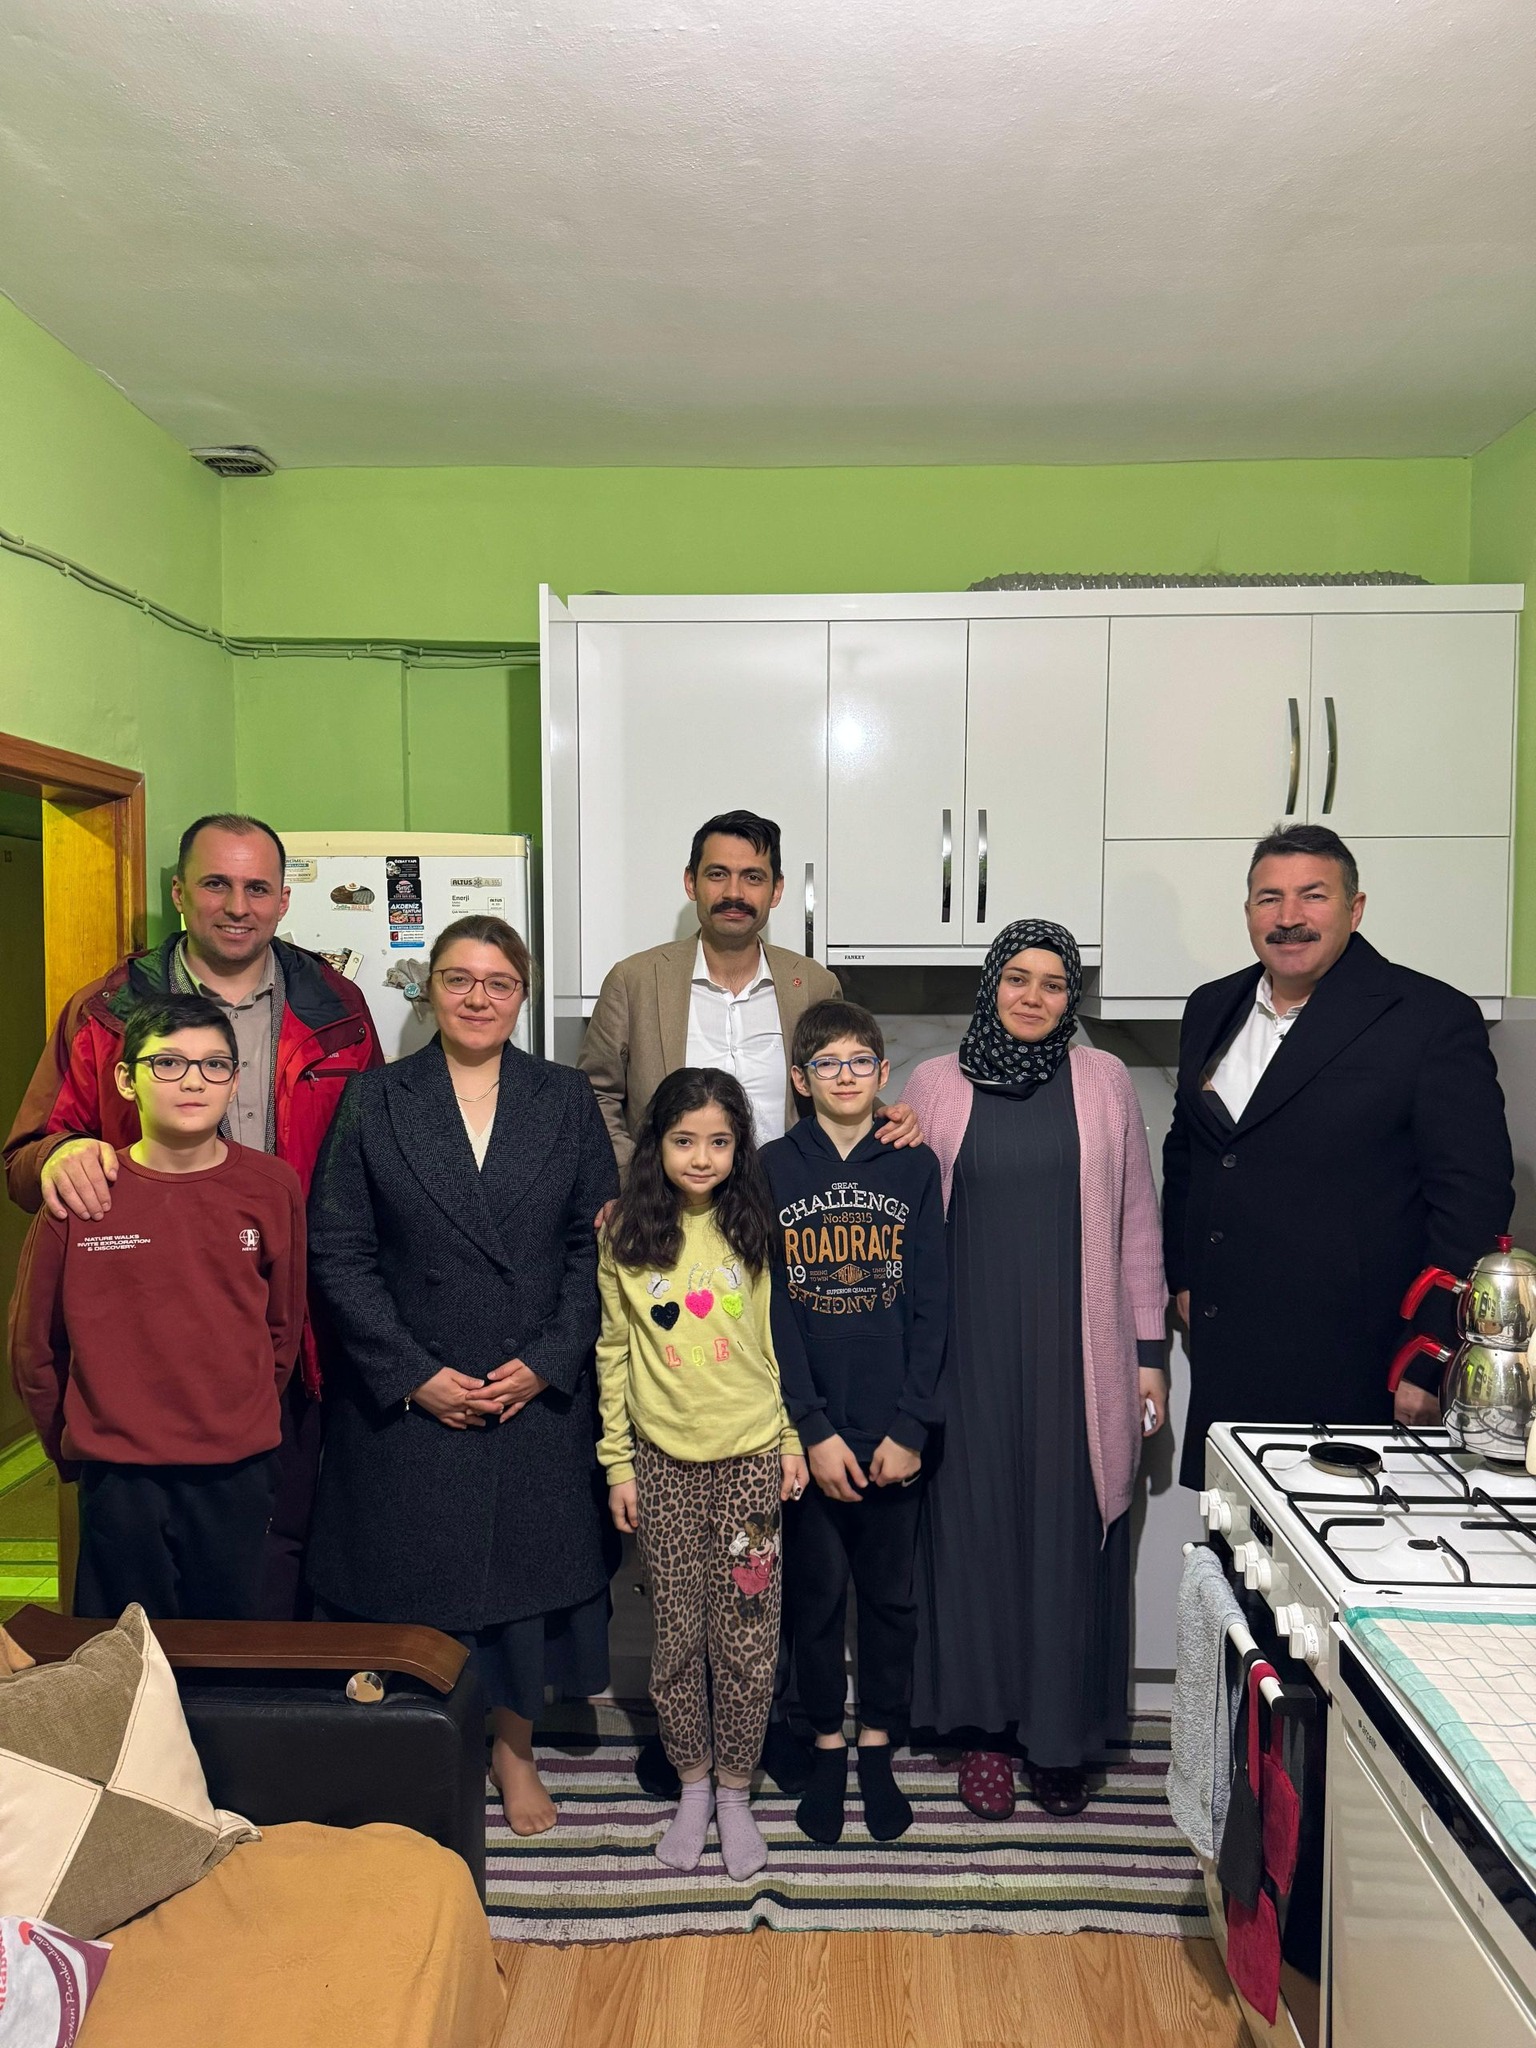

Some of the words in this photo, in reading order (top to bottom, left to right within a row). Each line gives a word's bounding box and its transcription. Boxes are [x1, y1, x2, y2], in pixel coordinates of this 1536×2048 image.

[390, 902, 420, 910] AKDENİZ
[831, 1182, 858, 1190] GREAT
[779, 1189, 909, 1227] CHALLENGE
[823, 1212, 872, 1223] No:85315
[784, 1224, 905, 1265] ROADRACE
[787, 1265, 807, 1284] 19
[886, 1260, 903, 1279] 88
[788, 1283, 878, 1314] ANGELES
